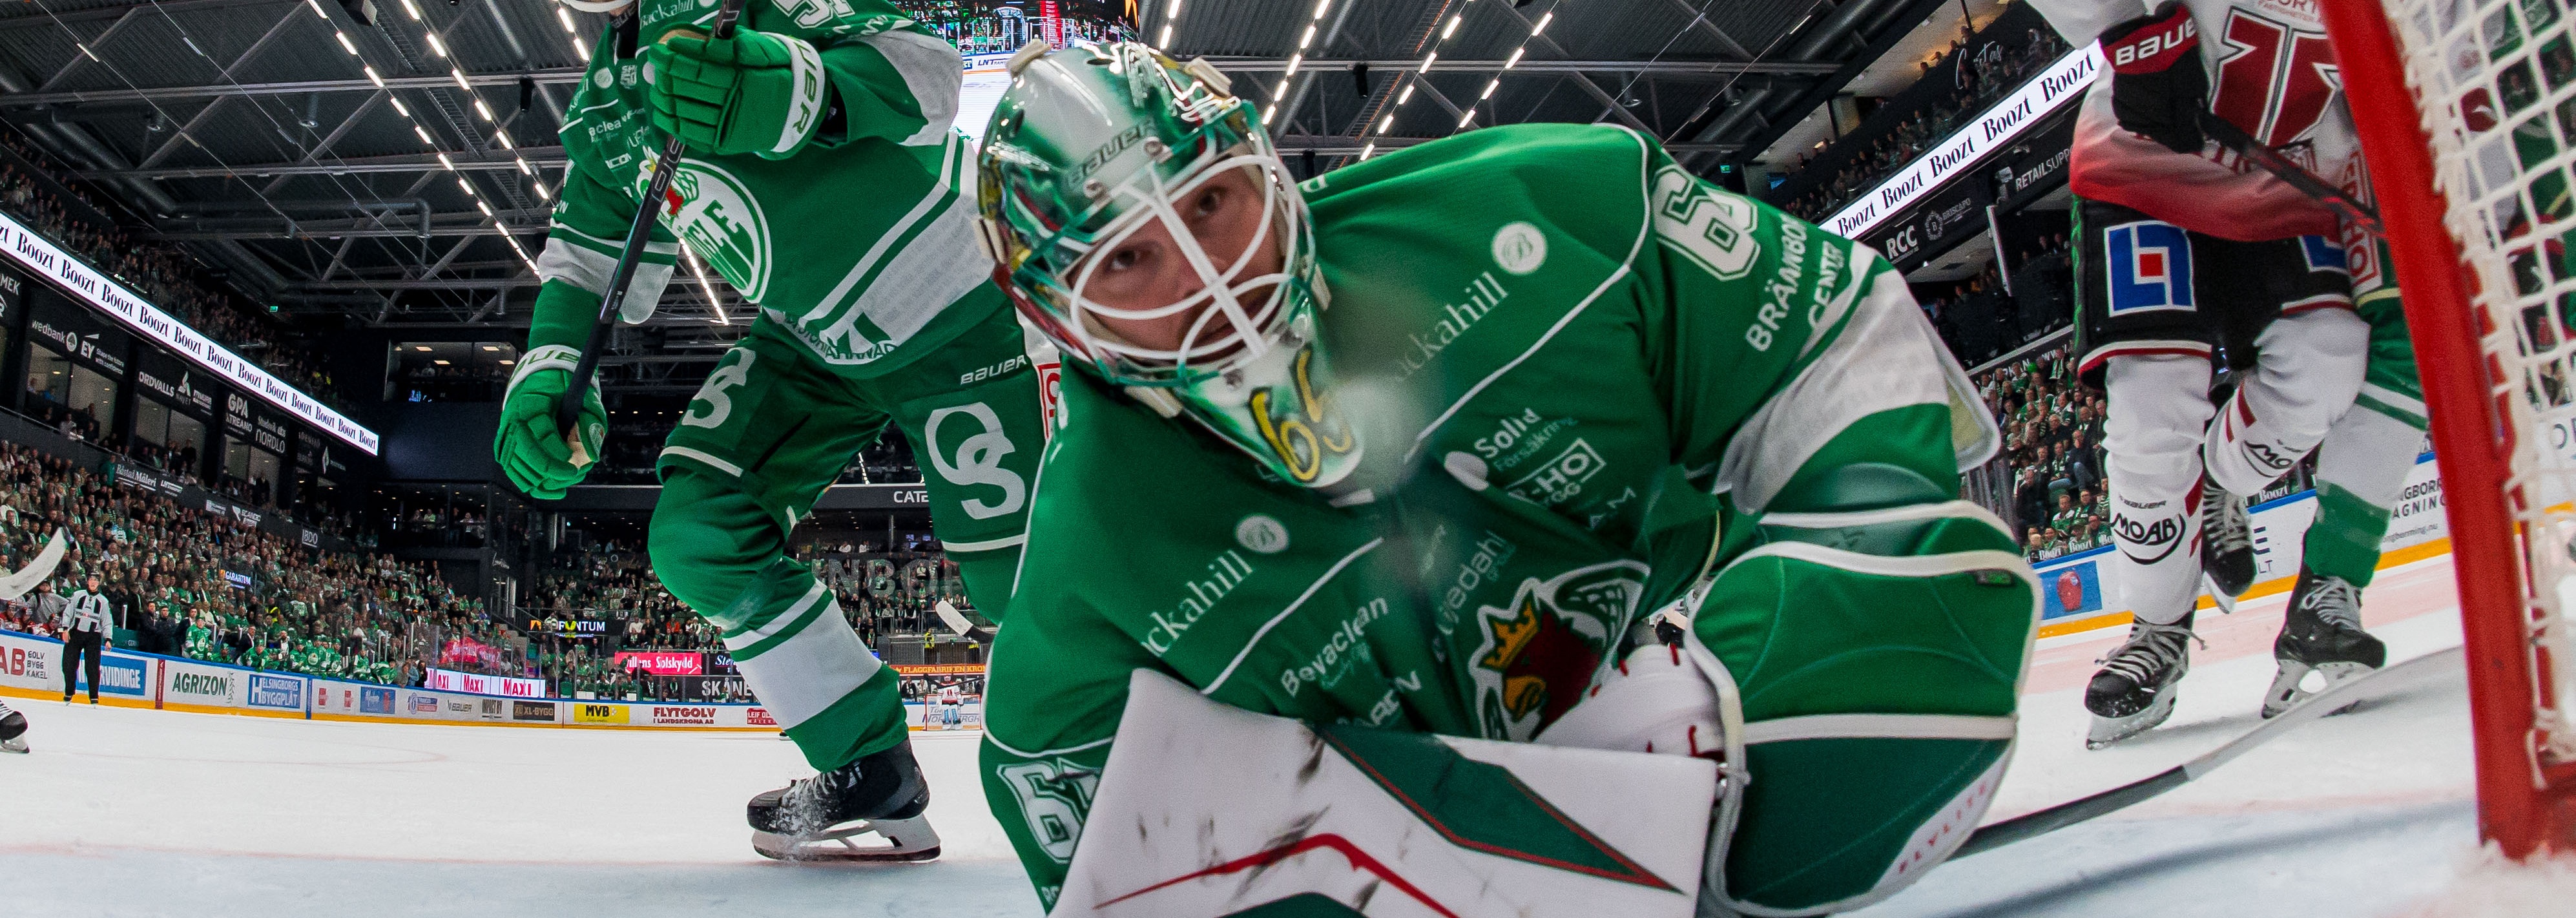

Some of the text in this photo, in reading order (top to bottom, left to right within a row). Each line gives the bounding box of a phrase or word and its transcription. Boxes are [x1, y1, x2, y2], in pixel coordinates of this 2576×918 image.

[1838, 200, 1876, 237] Boozt
[1882, 169, 1924, 209] Boozt
[1929, 134, 1975, 178] Boozt
[1982, 95, 2032, 143] Boozt
[2040, 52, 2094, 103] Boozt
[2015, 148, 2072, 191] RETAILSUPP
[1885, 225, 1918, 260] RCC
[16, 231, 54, 271] Boozt
[60, 258, 96, 295] Boozt
[101, 284, 133, 317] Boozt
[139, 305, 169, 337] Boozt
[174, 325, 202, 355] Boozt
[207, 344, 233, 372] Boozt
[238, 362, 261, 388] Boozt
[265, 377, 288, 403] Boozt
[291, 392, 312, 416] Boozt
[315, 405, 335, 428] Boozt
[338, 418, 357, 439] Boozt
[358, 430, 376, 450] Boozt
[32, 320, 65, 344] wedbank
[80, 340, 95, 359] EY
[138, 371, 175, 397] ORDVALLS
[227, 393, 249, 419] GPA
[172, 672, 227, 696] AGRIZON
[503, 678, 532, 696] MAXI
[524, 706, 554, 716] XL-BYGG
[585, 705, 610, 717] MVB
[654, 707, 716, 718] FLYTGOLV
